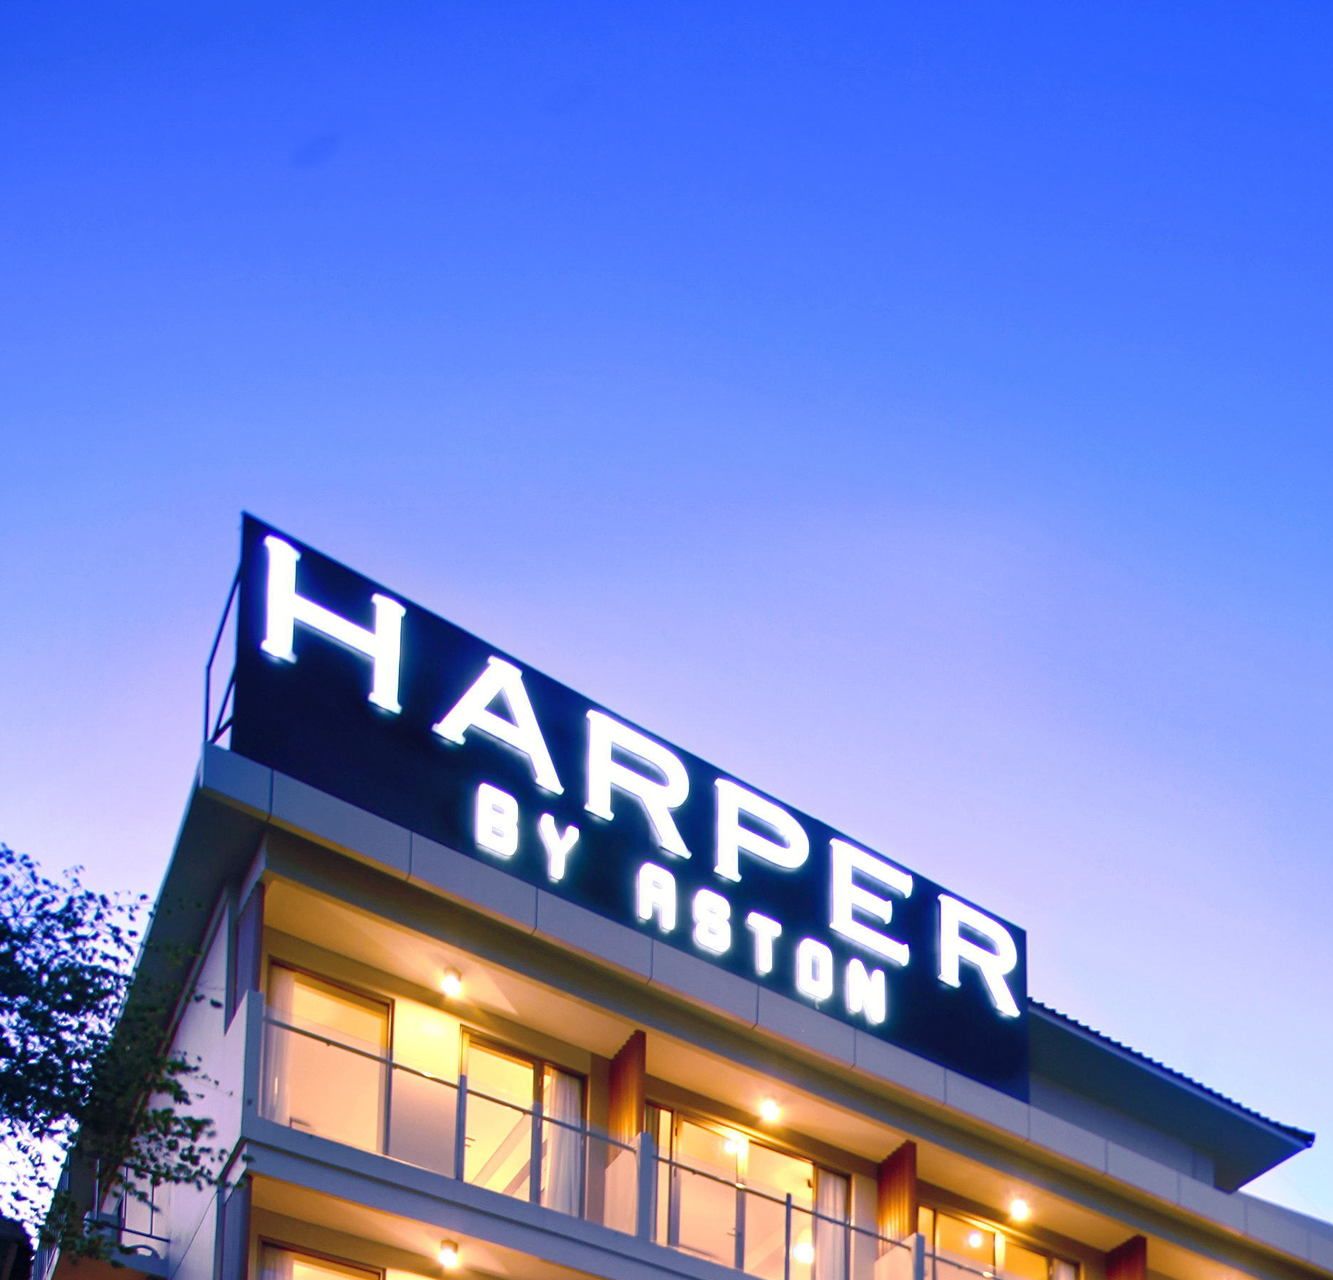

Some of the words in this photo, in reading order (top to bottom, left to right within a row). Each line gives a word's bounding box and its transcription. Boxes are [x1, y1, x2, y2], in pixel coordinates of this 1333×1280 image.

[262, 534, 1021, 1017] HARPER
[474, 782, 580, 882] BY
[635, 861, 886, 1024] ASTON
